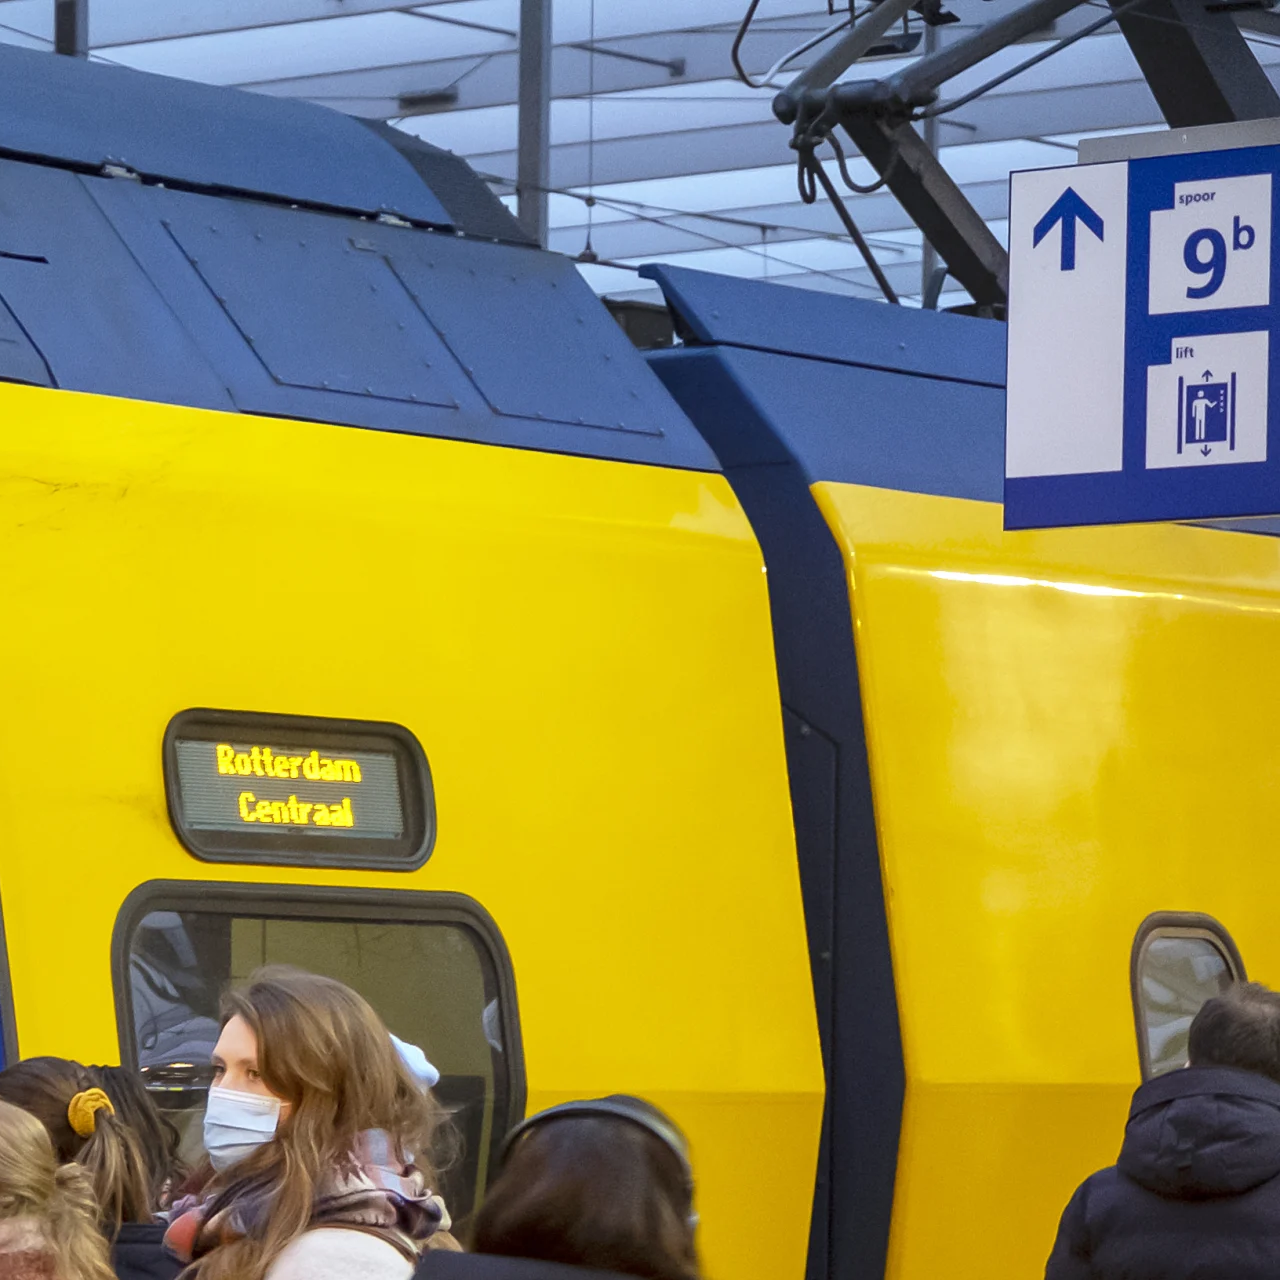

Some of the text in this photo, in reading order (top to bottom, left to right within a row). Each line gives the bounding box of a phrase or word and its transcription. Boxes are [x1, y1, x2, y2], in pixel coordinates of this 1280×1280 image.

[1179, 191, 1216, 206] spoor
[1176, 346, 1194, 359] lift
[215, 744, 362, 783] Rotterdam
[238, 791, 354, 828] Centraal
